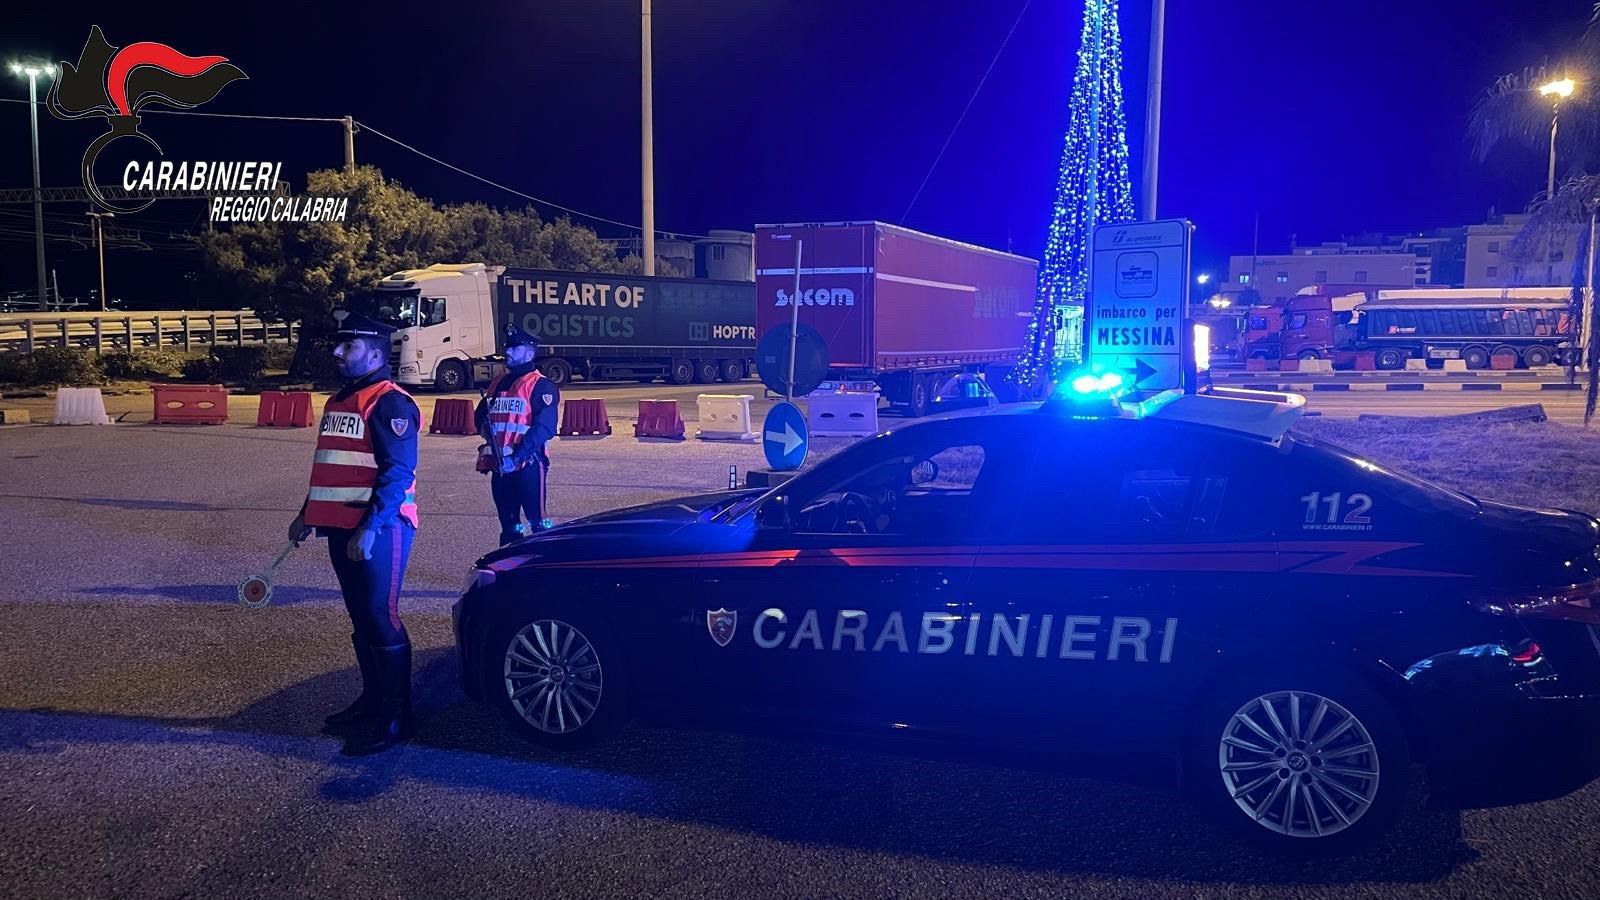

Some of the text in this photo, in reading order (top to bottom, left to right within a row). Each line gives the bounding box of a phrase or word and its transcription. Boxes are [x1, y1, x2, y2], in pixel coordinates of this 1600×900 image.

[507, 279, 559, 304] THE
[563, 282, 610, 307] ART
[614, 285, 645, 308] OF
[1097, 305, 1177, 321] imbarco per
[1098, 327, 1175, 346] MESSINA
[1301, 491, 1373, 523] 112
[753, 608, 1178, 663] CARABINIERI
